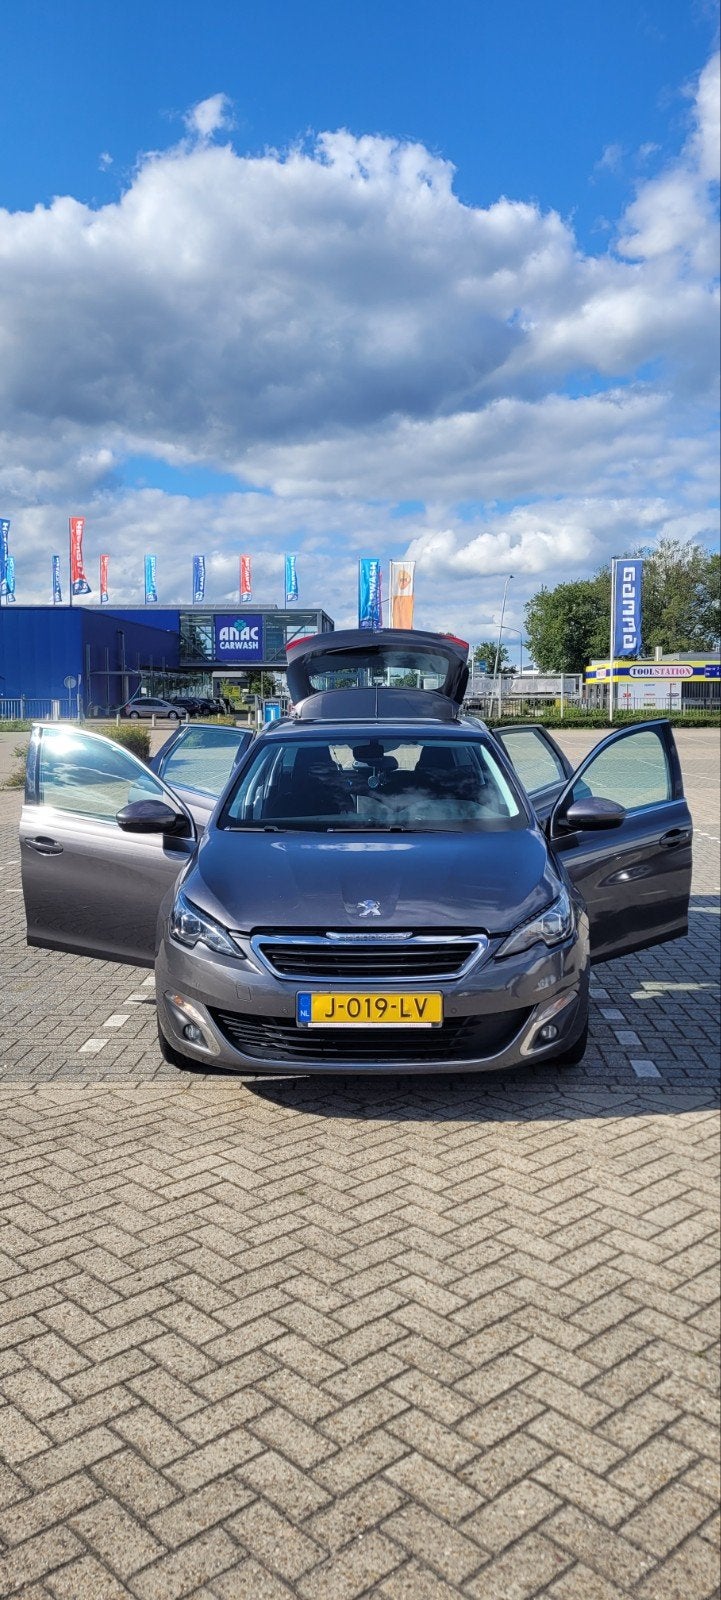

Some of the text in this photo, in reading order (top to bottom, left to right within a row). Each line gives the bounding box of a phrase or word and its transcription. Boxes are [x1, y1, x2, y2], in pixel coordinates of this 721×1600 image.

[219, 626, 259, 640] ANAC
[219, 641, 259, 650] CARWASH
[324, 997, 428, 1018] J-019-LV
